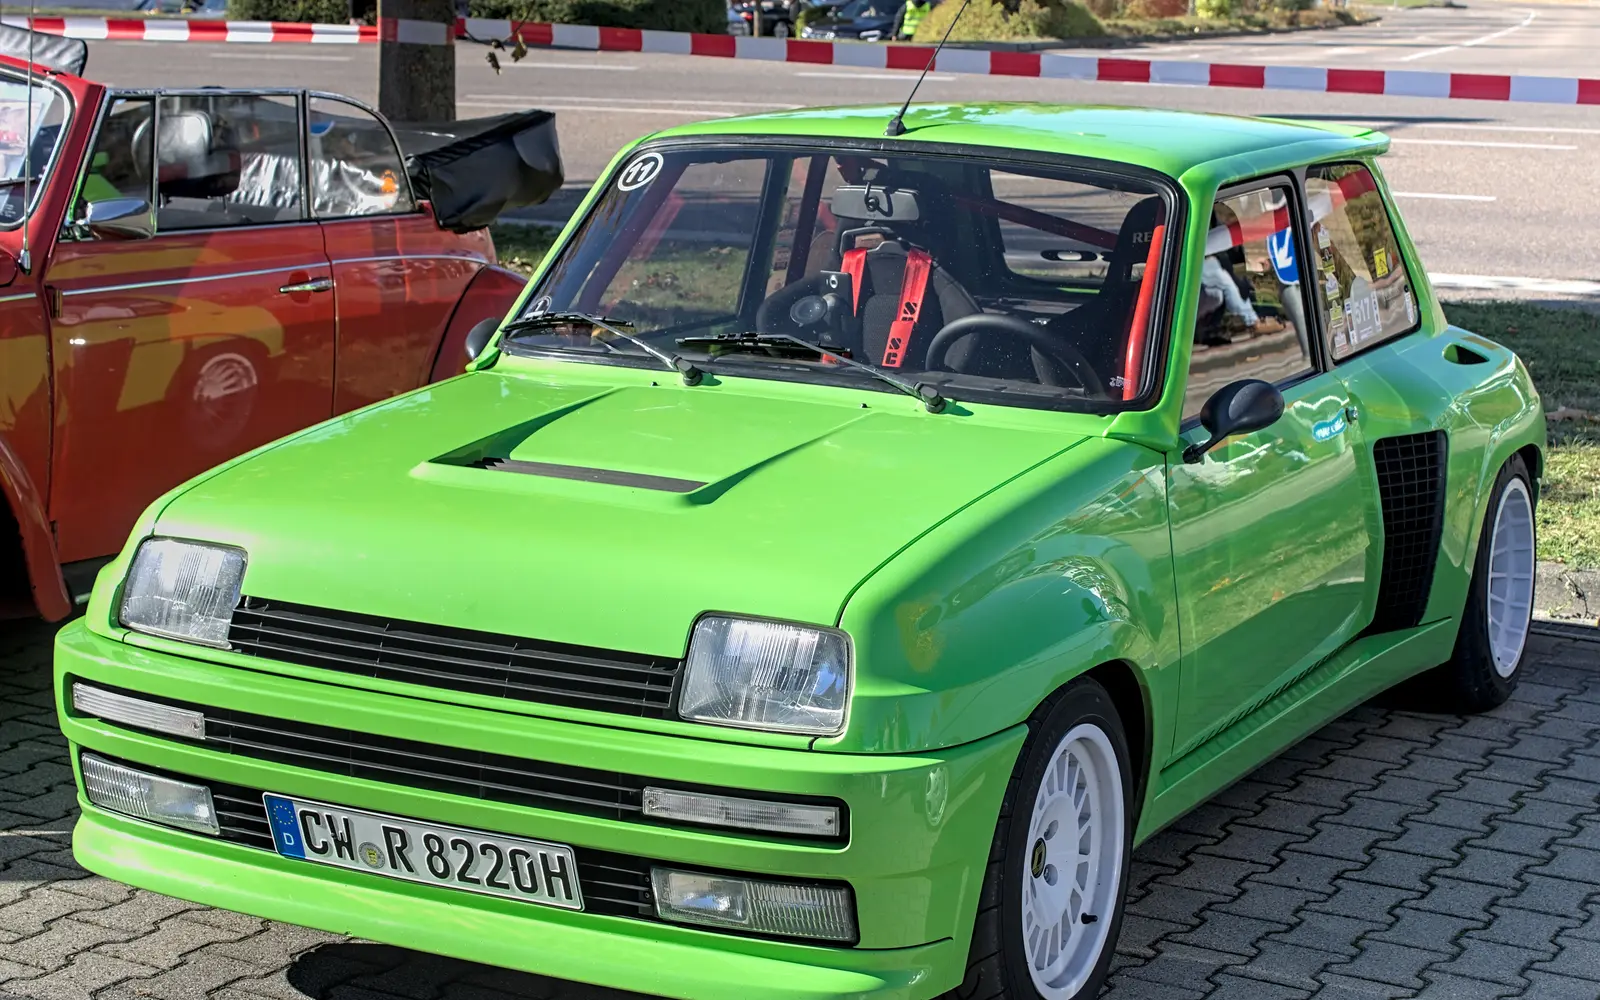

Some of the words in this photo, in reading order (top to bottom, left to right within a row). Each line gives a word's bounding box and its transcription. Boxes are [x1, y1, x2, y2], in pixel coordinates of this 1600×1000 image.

[625, 161, 656, 183] 11
[282, 831, 294, 846] D
[298, 808, 356, 862] CW
[381, 824, 415, 873] R
[421, 831, 574, 901] 8220H
